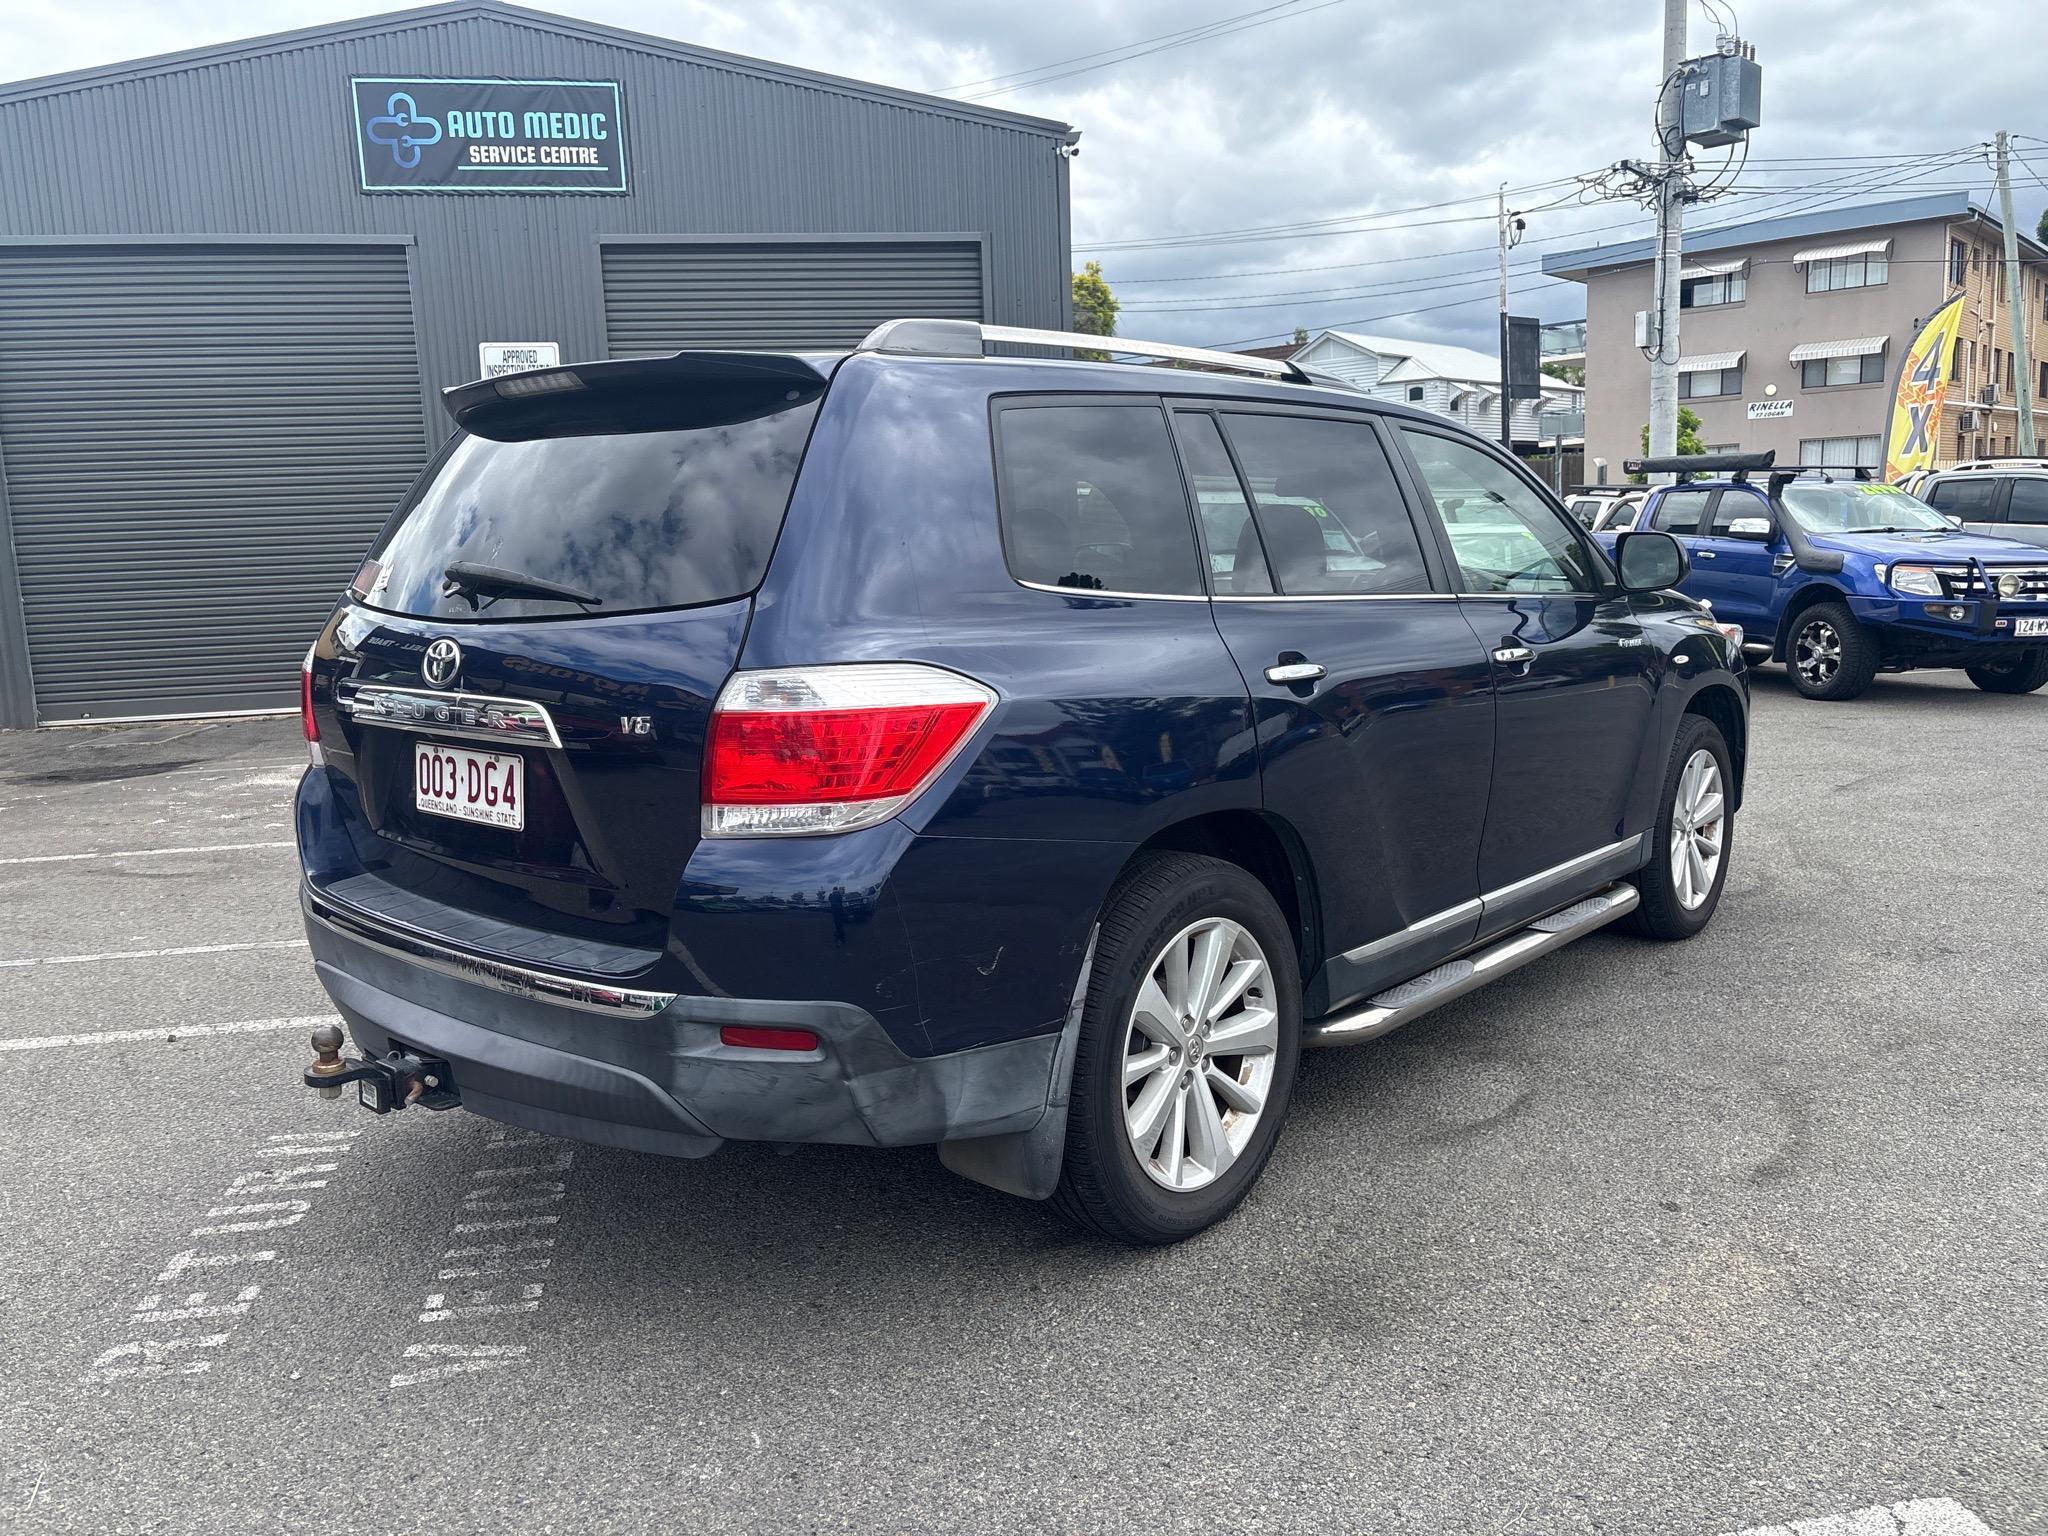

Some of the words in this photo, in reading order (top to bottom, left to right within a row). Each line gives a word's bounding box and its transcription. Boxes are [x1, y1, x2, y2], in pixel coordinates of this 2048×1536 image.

[447, 111, 515, 139] AUTO
[523, 112, 607, 140] MEDIC
[469, 145, 537, 164] SERVICE
[540, 147, 599, 165] CENTRE
[503, 350, 537, 363] APPROVED
[1749, 401, 1793, 412] RINELLA
[373, 696, 506, 729] KLUGER
[620, 716, 651, 735] V6
[420, 798, 458, 814] QUEENSLAND
[463, 805, 494, 821] SUNSHINE
[496, 812, 517, 826] STATE
